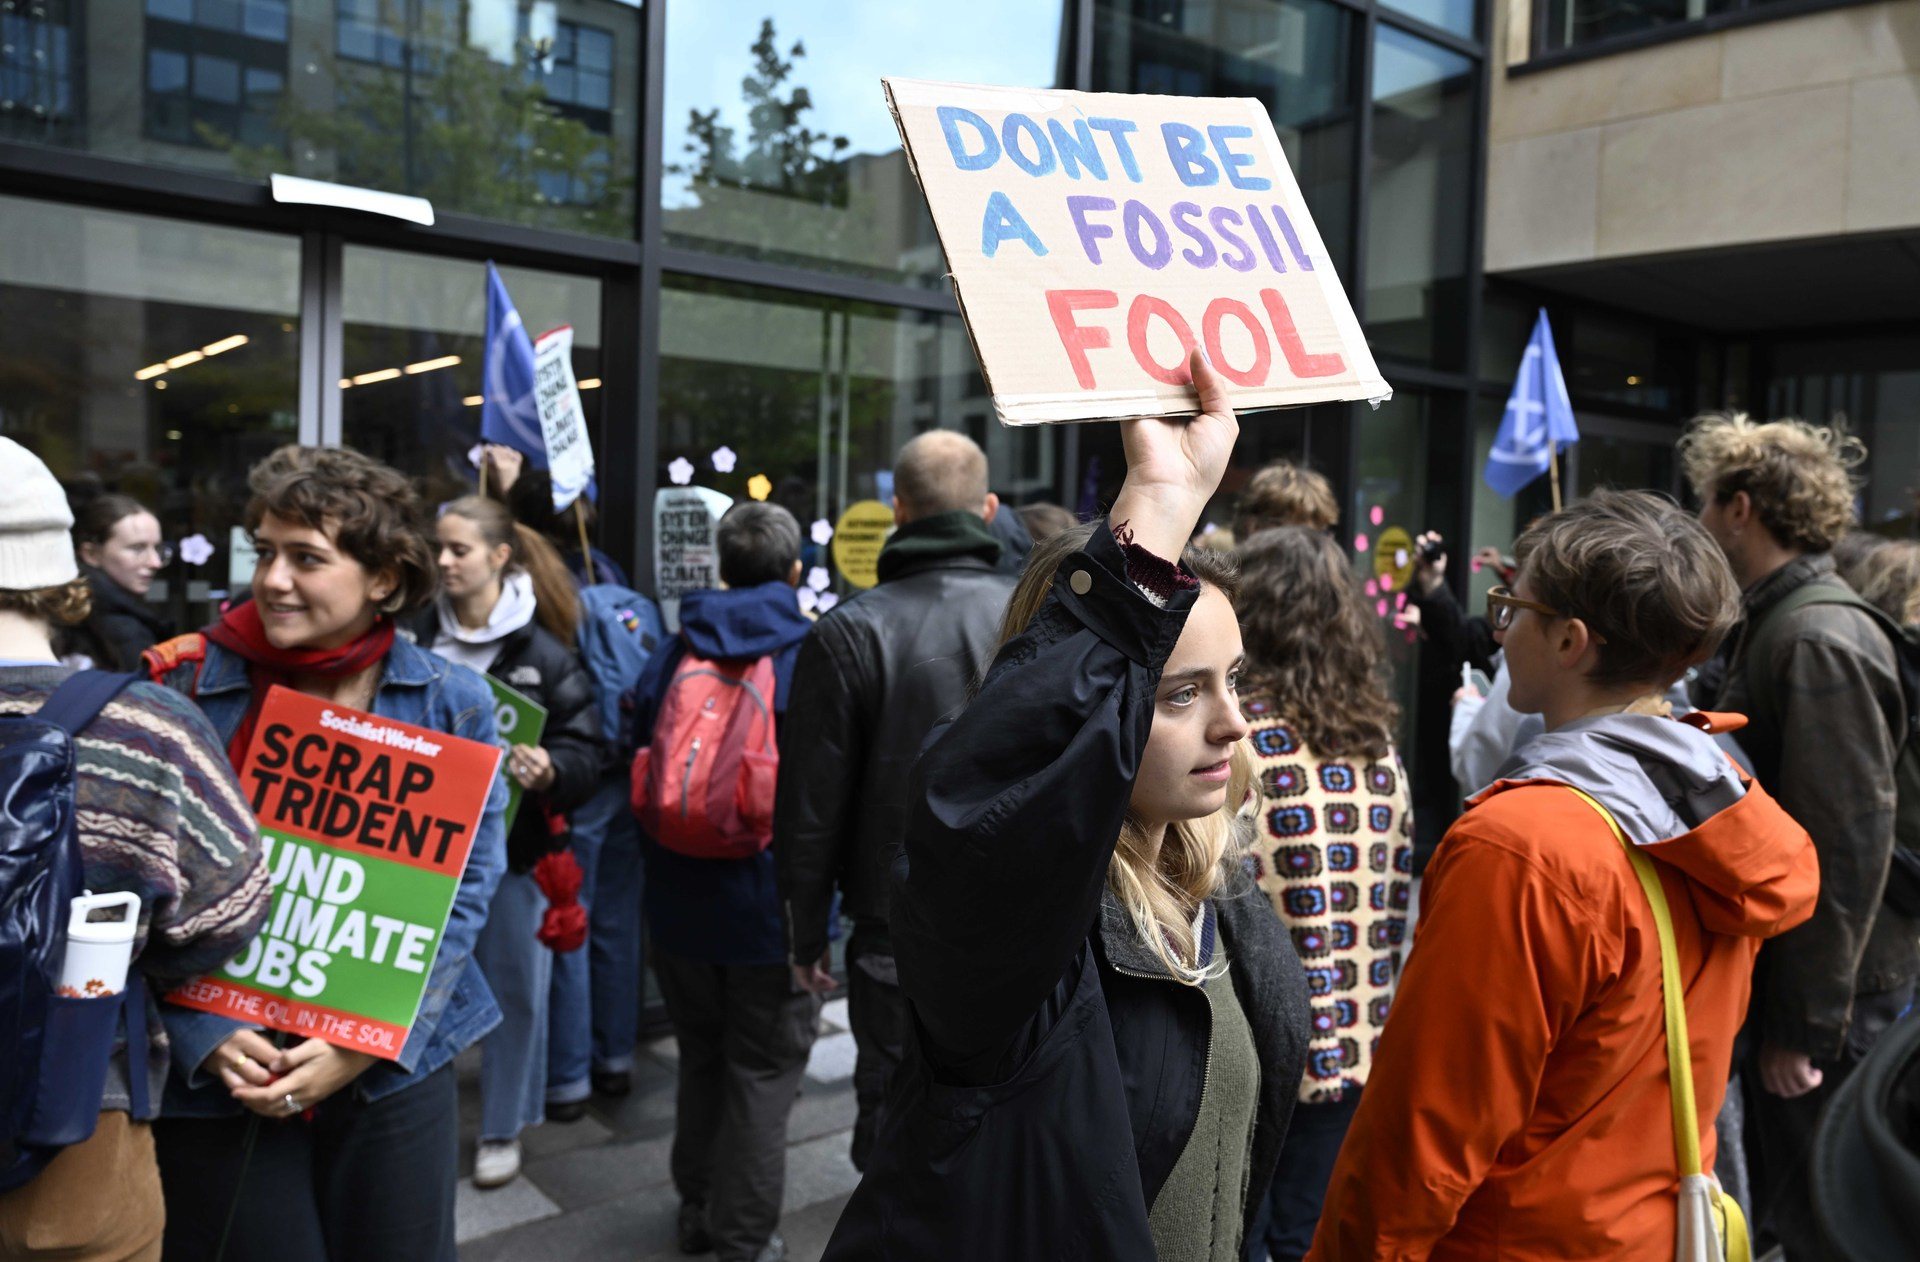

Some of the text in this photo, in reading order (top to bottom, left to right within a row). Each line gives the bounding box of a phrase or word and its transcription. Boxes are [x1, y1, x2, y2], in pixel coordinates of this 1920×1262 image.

[1160, 121, 1273, 192] BE
[981, 190, 1315, 274] A FOSSIL
[1045, 287, 1348, 390] FOOL
[256, 722, 434, 805] SCRAP
[251, 767, 466, 864] TRIDENT
[260, 835, 366, 906] UND
[223, 935, 332, 999] OBS
[261, 890, 436, 974] IMATE
[226, 988, 264, 1016] THE
[296, 1009, 319, 1029] IN
[319, 1013, 357, 1039] THE
[356, 1023, 395, 1052] SOIL
